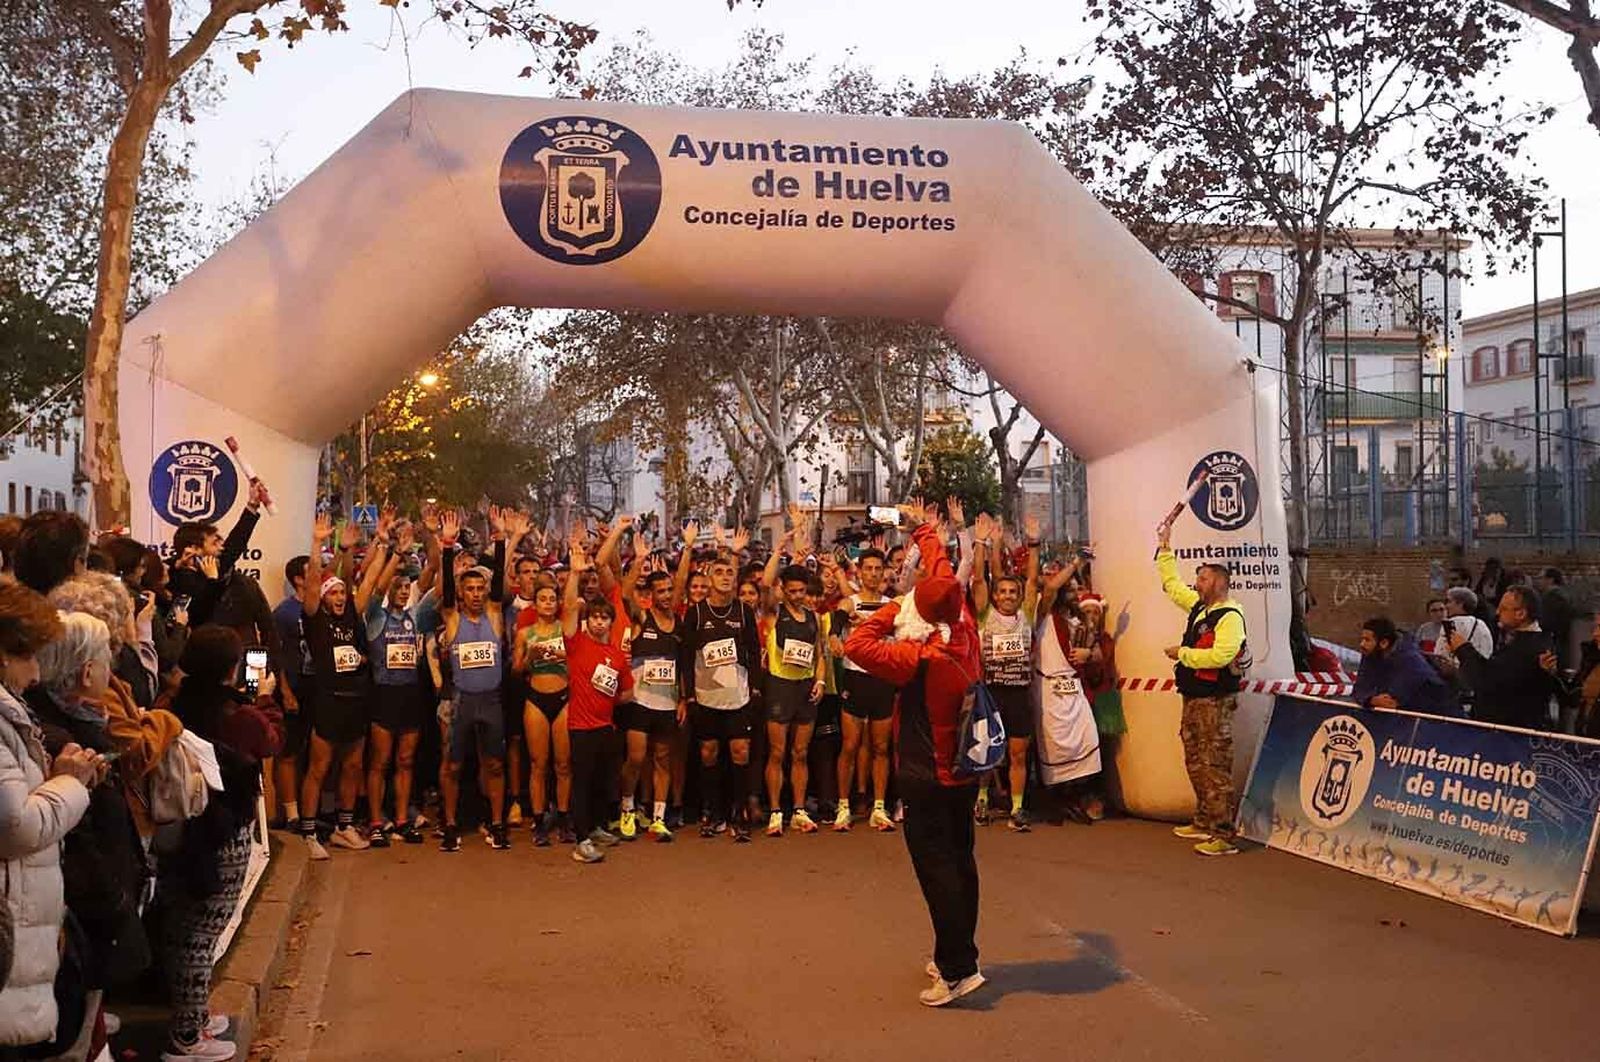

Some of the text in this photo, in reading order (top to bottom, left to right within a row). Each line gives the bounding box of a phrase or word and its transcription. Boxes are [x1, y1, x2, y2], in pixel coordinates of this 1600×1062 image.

[668, 134, 949, 168] Ayuntamiento
[752, 169, 952, 203] de Huelva
[684, 206, 956, 233] Concejalía de Deportes
[1228, 561, 1280, 576] Huelva
[1229, 580, 1243, 590] de
[474, 649, 491, 660] 385
[717, 646, 734, 658] 185
[1006, 640, 1021, 651] 286
[658, 668, 672, 678] 191
[1380, 739, 1536, 789] Ayuntamiento
[1406, 772, 1436, 797] de
[1440, 777, 1531, 819] Huelva
[1439, 809, 1457, 825] de
[1461, 814, 1528, 844] Deportes
